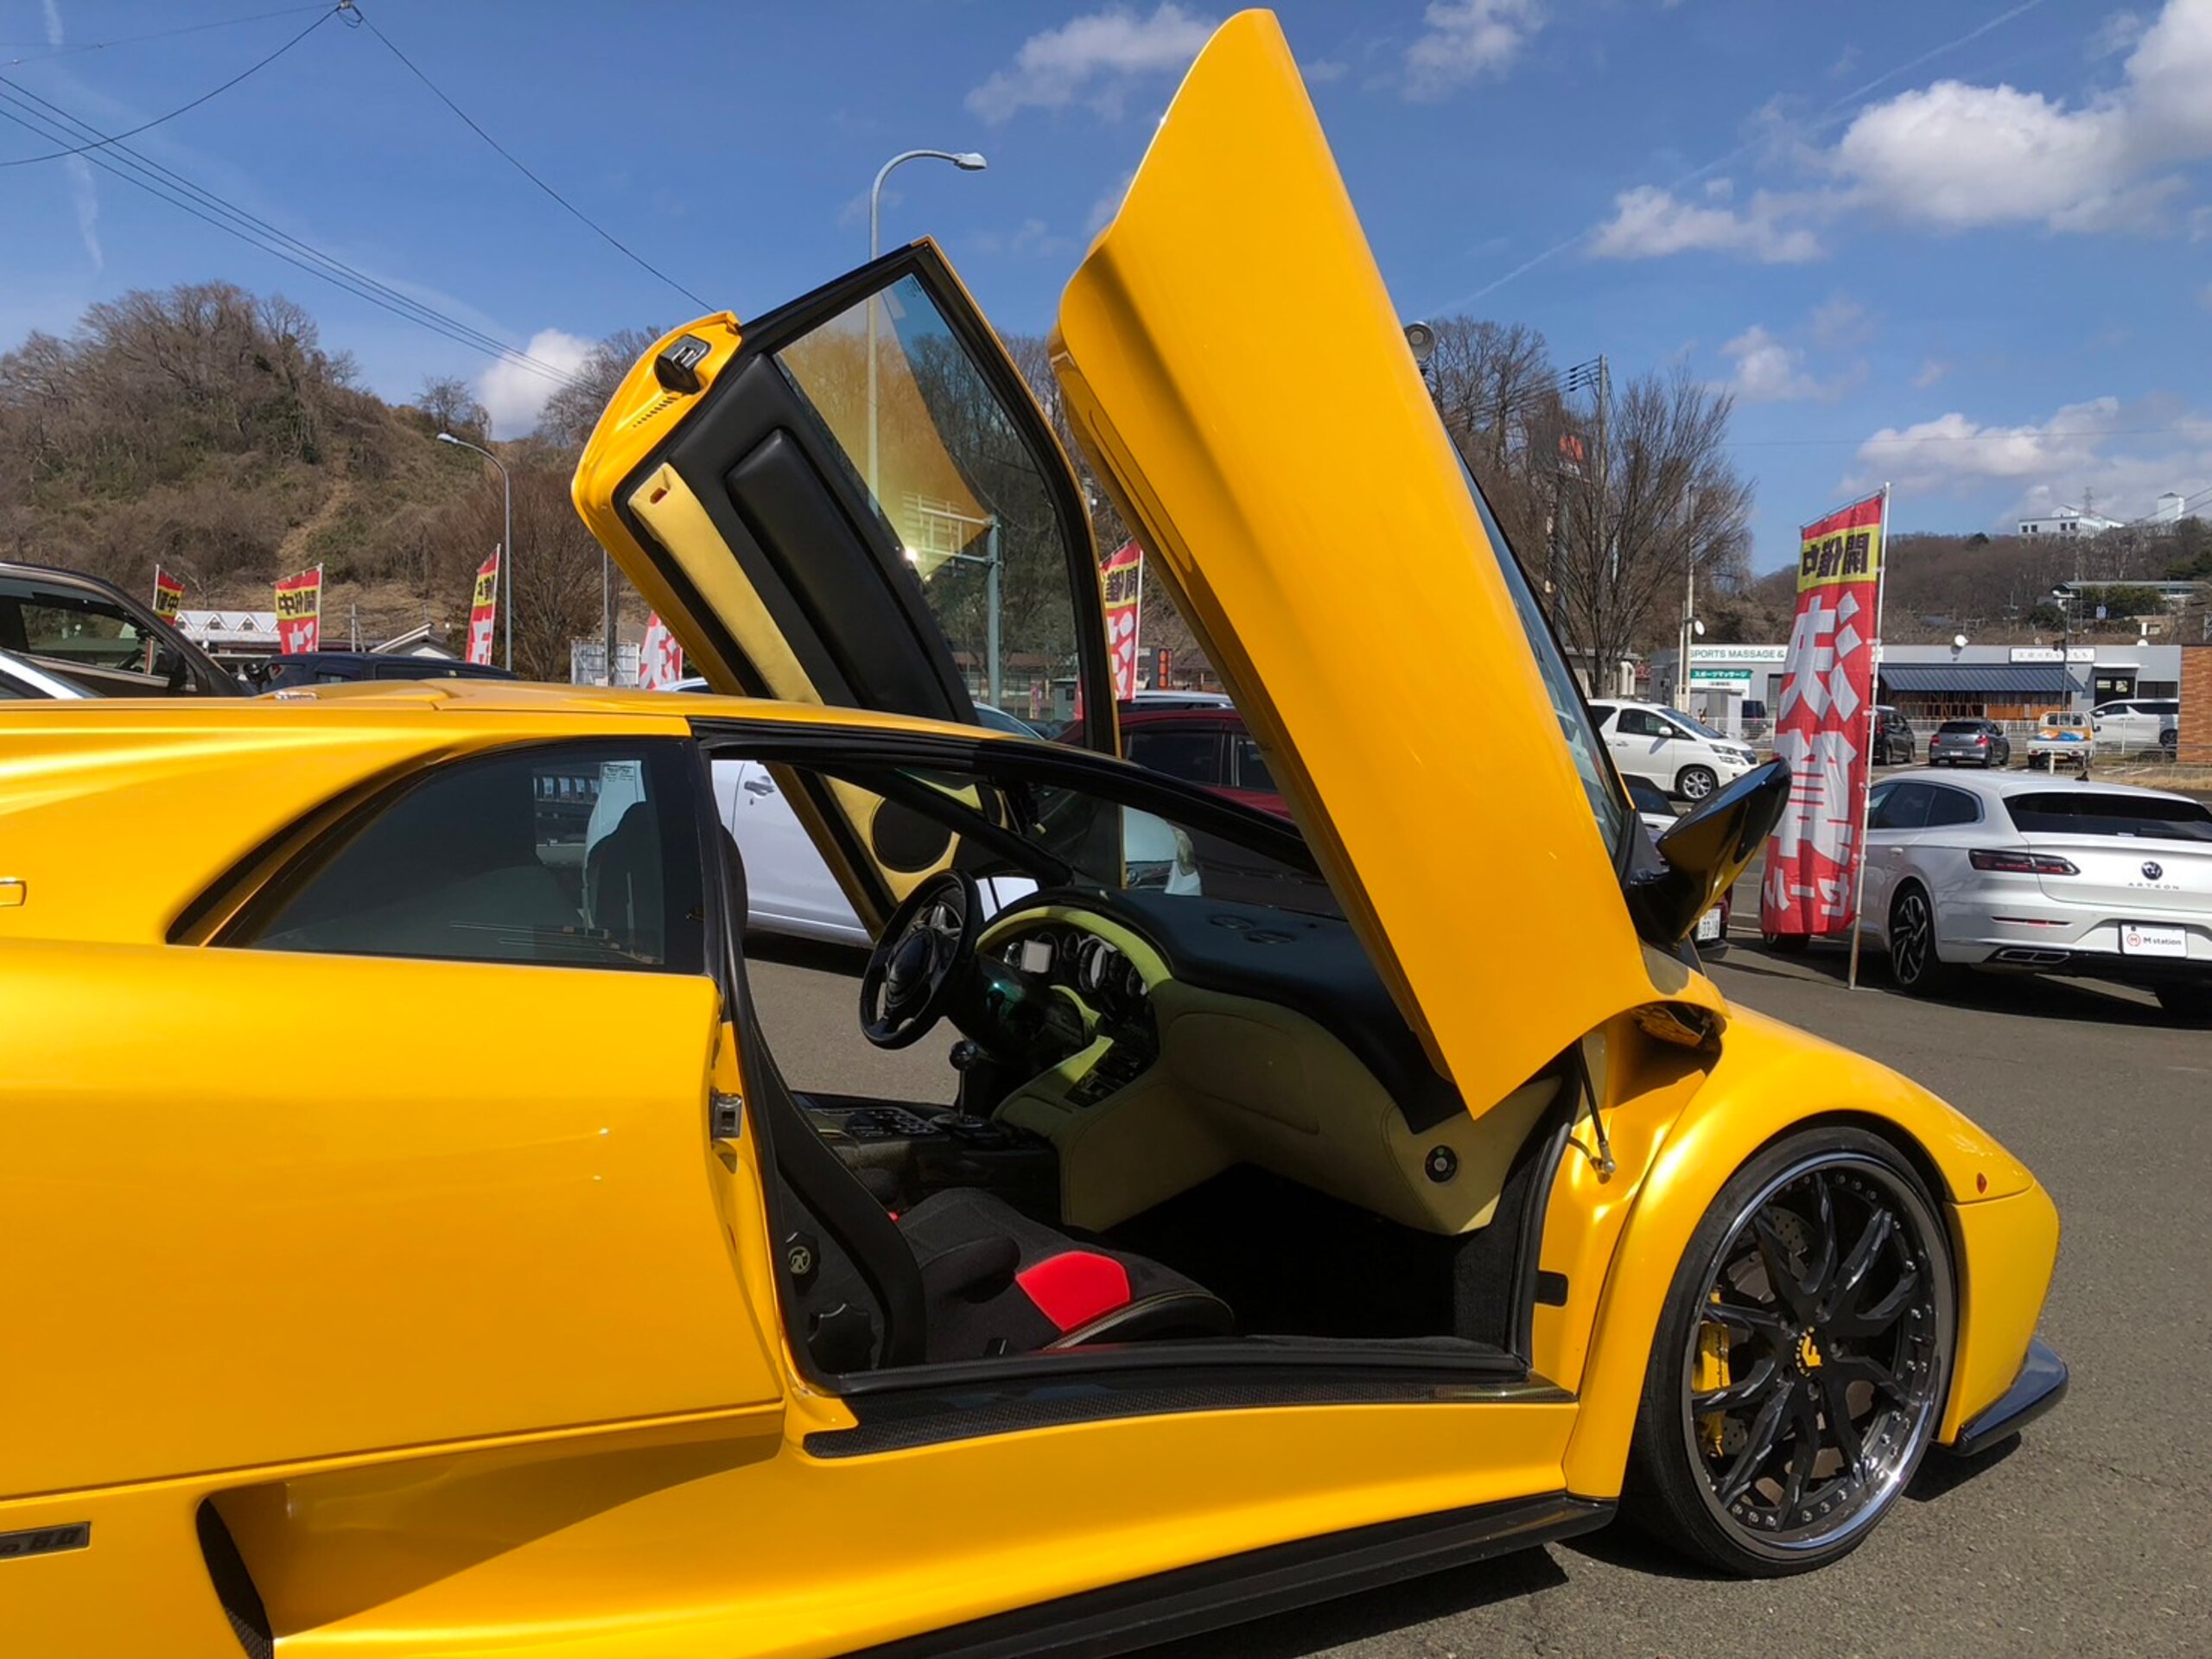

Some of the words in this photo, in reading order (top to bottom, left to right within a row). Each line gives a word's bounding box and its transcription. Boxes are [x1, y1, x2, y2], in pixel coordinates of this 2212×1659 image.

[1690, 649, 1726, 658] SPORTS
[1728, 649, 1775, 658] MASSAGE
[1777, 650, 1784, 658] &
